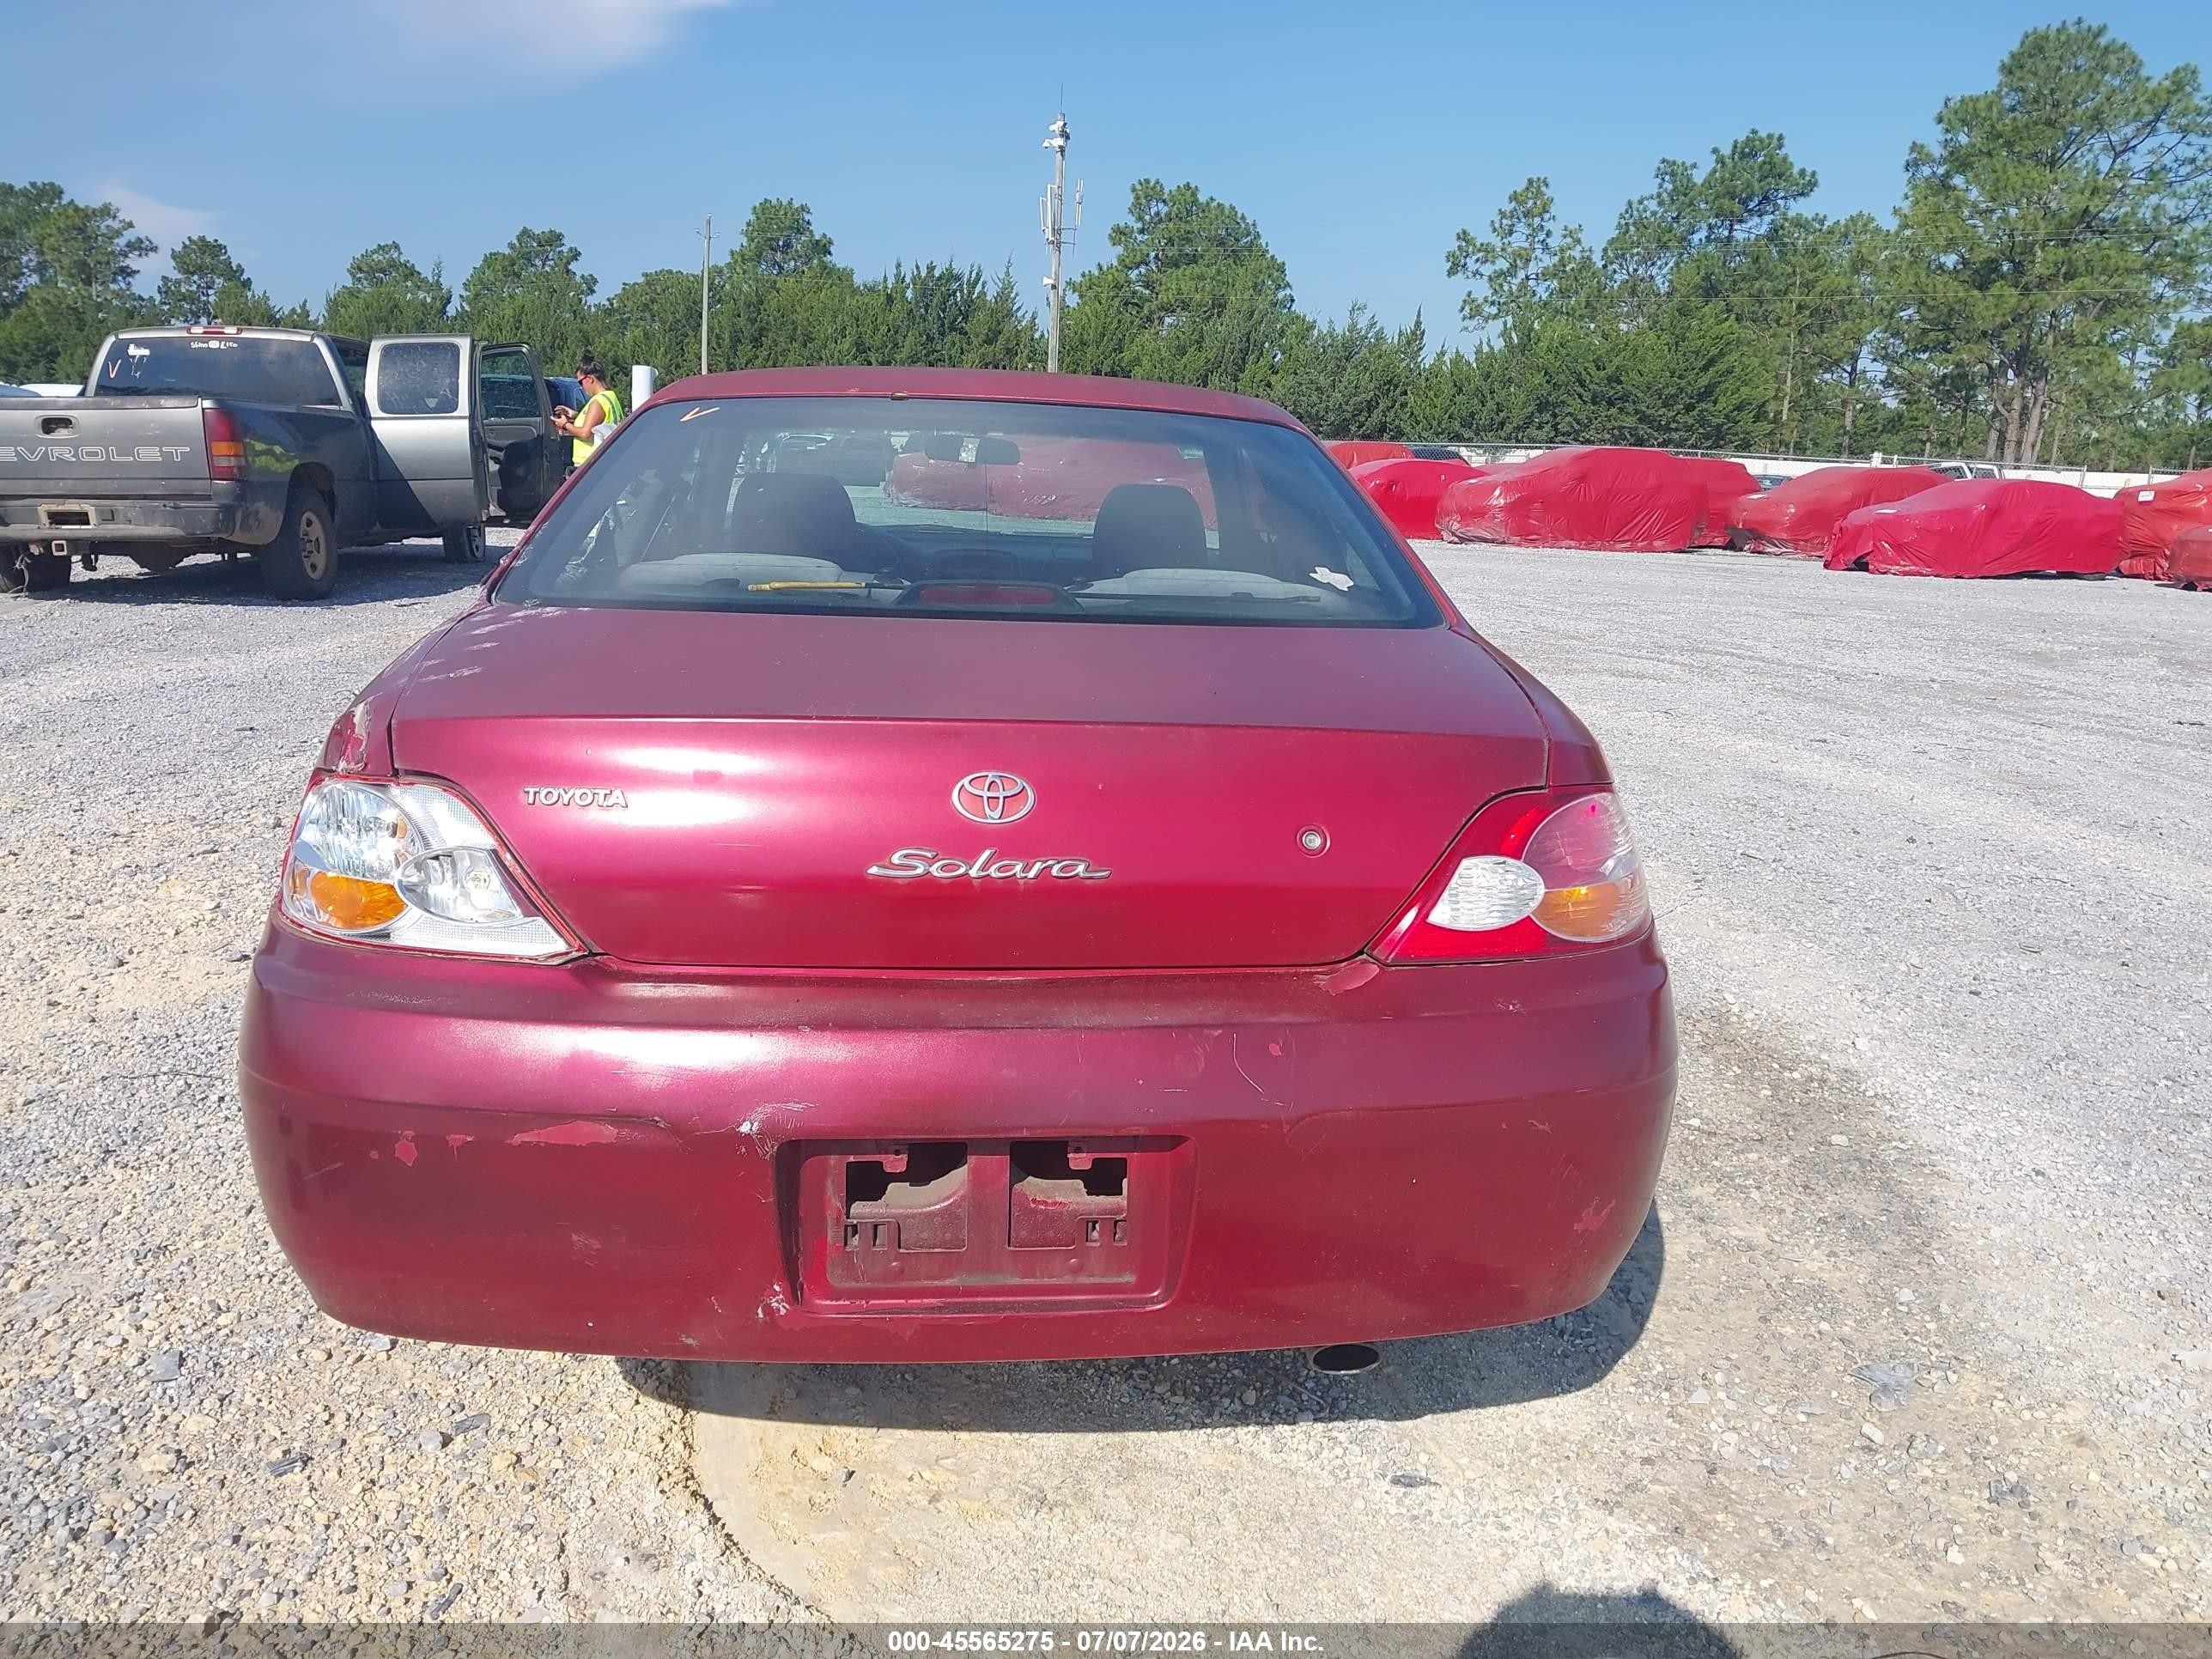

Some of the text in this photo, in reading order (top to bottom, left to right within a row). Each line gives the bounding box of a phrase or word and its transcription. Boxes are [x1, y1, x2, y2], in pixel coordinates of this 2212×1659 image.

[0, 447, 191, 462] EVROLET
[524, 787, 629, 808] TOYOTA
[866, 848, 1113, 879] Solara
